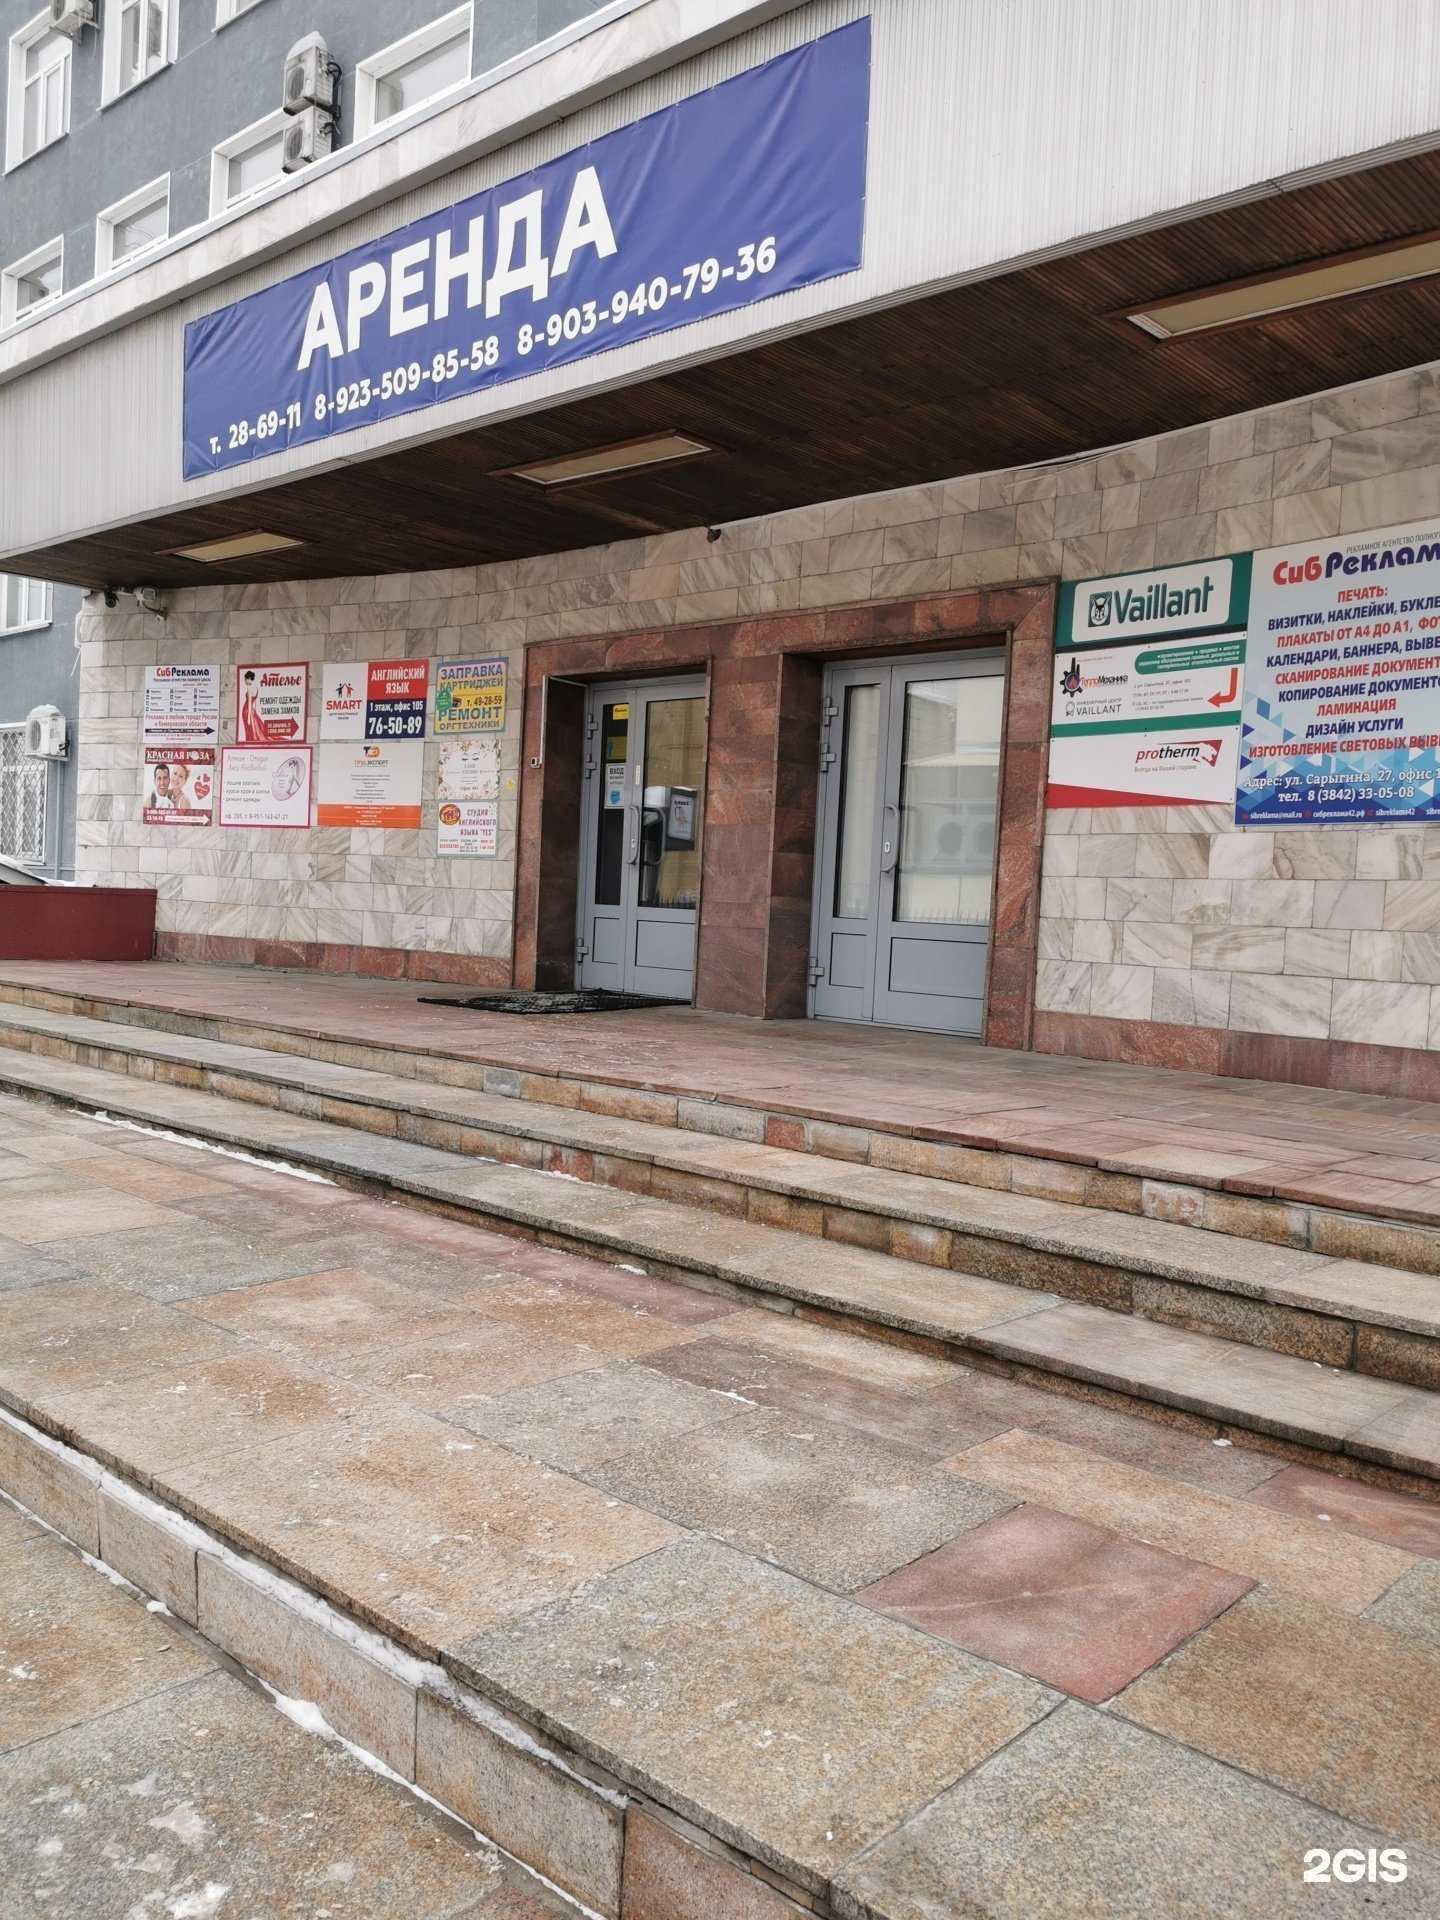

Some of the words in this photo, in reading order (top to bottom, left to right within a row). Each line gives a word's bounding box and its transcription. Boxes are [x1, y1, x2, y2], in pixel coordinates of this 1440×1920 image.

[297, 165, 618, 371] АРЕНДА
[209, 436, 221, 454] т.
[229, 402, 301, 449] 28-69-11
[314, 335, 500, 421] 8-923-509-85-58
[517, 237, 777, 356] 8-903-940-79-36
[1113, 576, 1214, 624] Vaillant
[1337, 585, 1388, 603] ПЕЧАТЬ:
[1268, 611, 1325, 631] ВИЗИТКИ,
[1327, 601, 1398, 623] НАКЛЕЙКИ,
[1277, 630, 1334, 648] ПЛАКАТЫ
[1337, 627, 1353, 641] ОТ
[1354, 625, 1370, 639] А4
[1372, 622, 1391, 638] ДО
[1393, 620, 1413, 633] А1,
[1266, 648, 1341, 668] КАЛЕНДАРИ,
[1343, 640, 1403, 659] БАННЕРА,
[260, 672, 302, 687] Ателье
[371, 664, 425, 681] АНГЛИЙСКИЙ
[440, 664, 503, 680] ЗАПРАВКА
[1275, 663, 1370, 685] СКАНИРОВАНИЕ
[385, 682, 410, 695] ЯЗЫК
[1278, 683, 1367, 703] КОПИРОВАНИЕ
[326, 700, 362, 710] SMART
[394, 701, 411, 713] офис
[412, 701, 423, 711] 105
[439, 706, 502, 721] РЕМОНТ
[1076, 704, 1122, 716] VAILLANT
[1316, 698, 1397, 717] ЛАМИНАЦИЯ
[368, 716, 422, 735] 76-50-89
[440, 720, 500, 730] ОРГТЕХНИКИ
[1305, 719, 1355, 739] ДИЗАЙН
[1358, 717, 1404, 733] УСЛУГИ
[147, 750, 185, 760] КРАСНАЯ
[1135, 745, 1200, 764] protherm
[1248, 741, 1338, 758] ИЗГОТОВЛЕНИЕ
[1340, 736, 1407, 753] СВЕТОВЫХ
[1244, 775, 1283, 790] Адрес:
[1284, 776, 1303, 789] ул.
[1306, 772, 1374, 788] Сарыгина,
[1376, 769, 1396, 782] 27,
[1398, 768, 1433, 784] офис
[1278, 792, 1302, 803] тел.
[1307, 790, 1316, 801] 8
[1317, 787, 1356, 804] (3842)
[1358, 785, 1415, 800] 33-05-08
